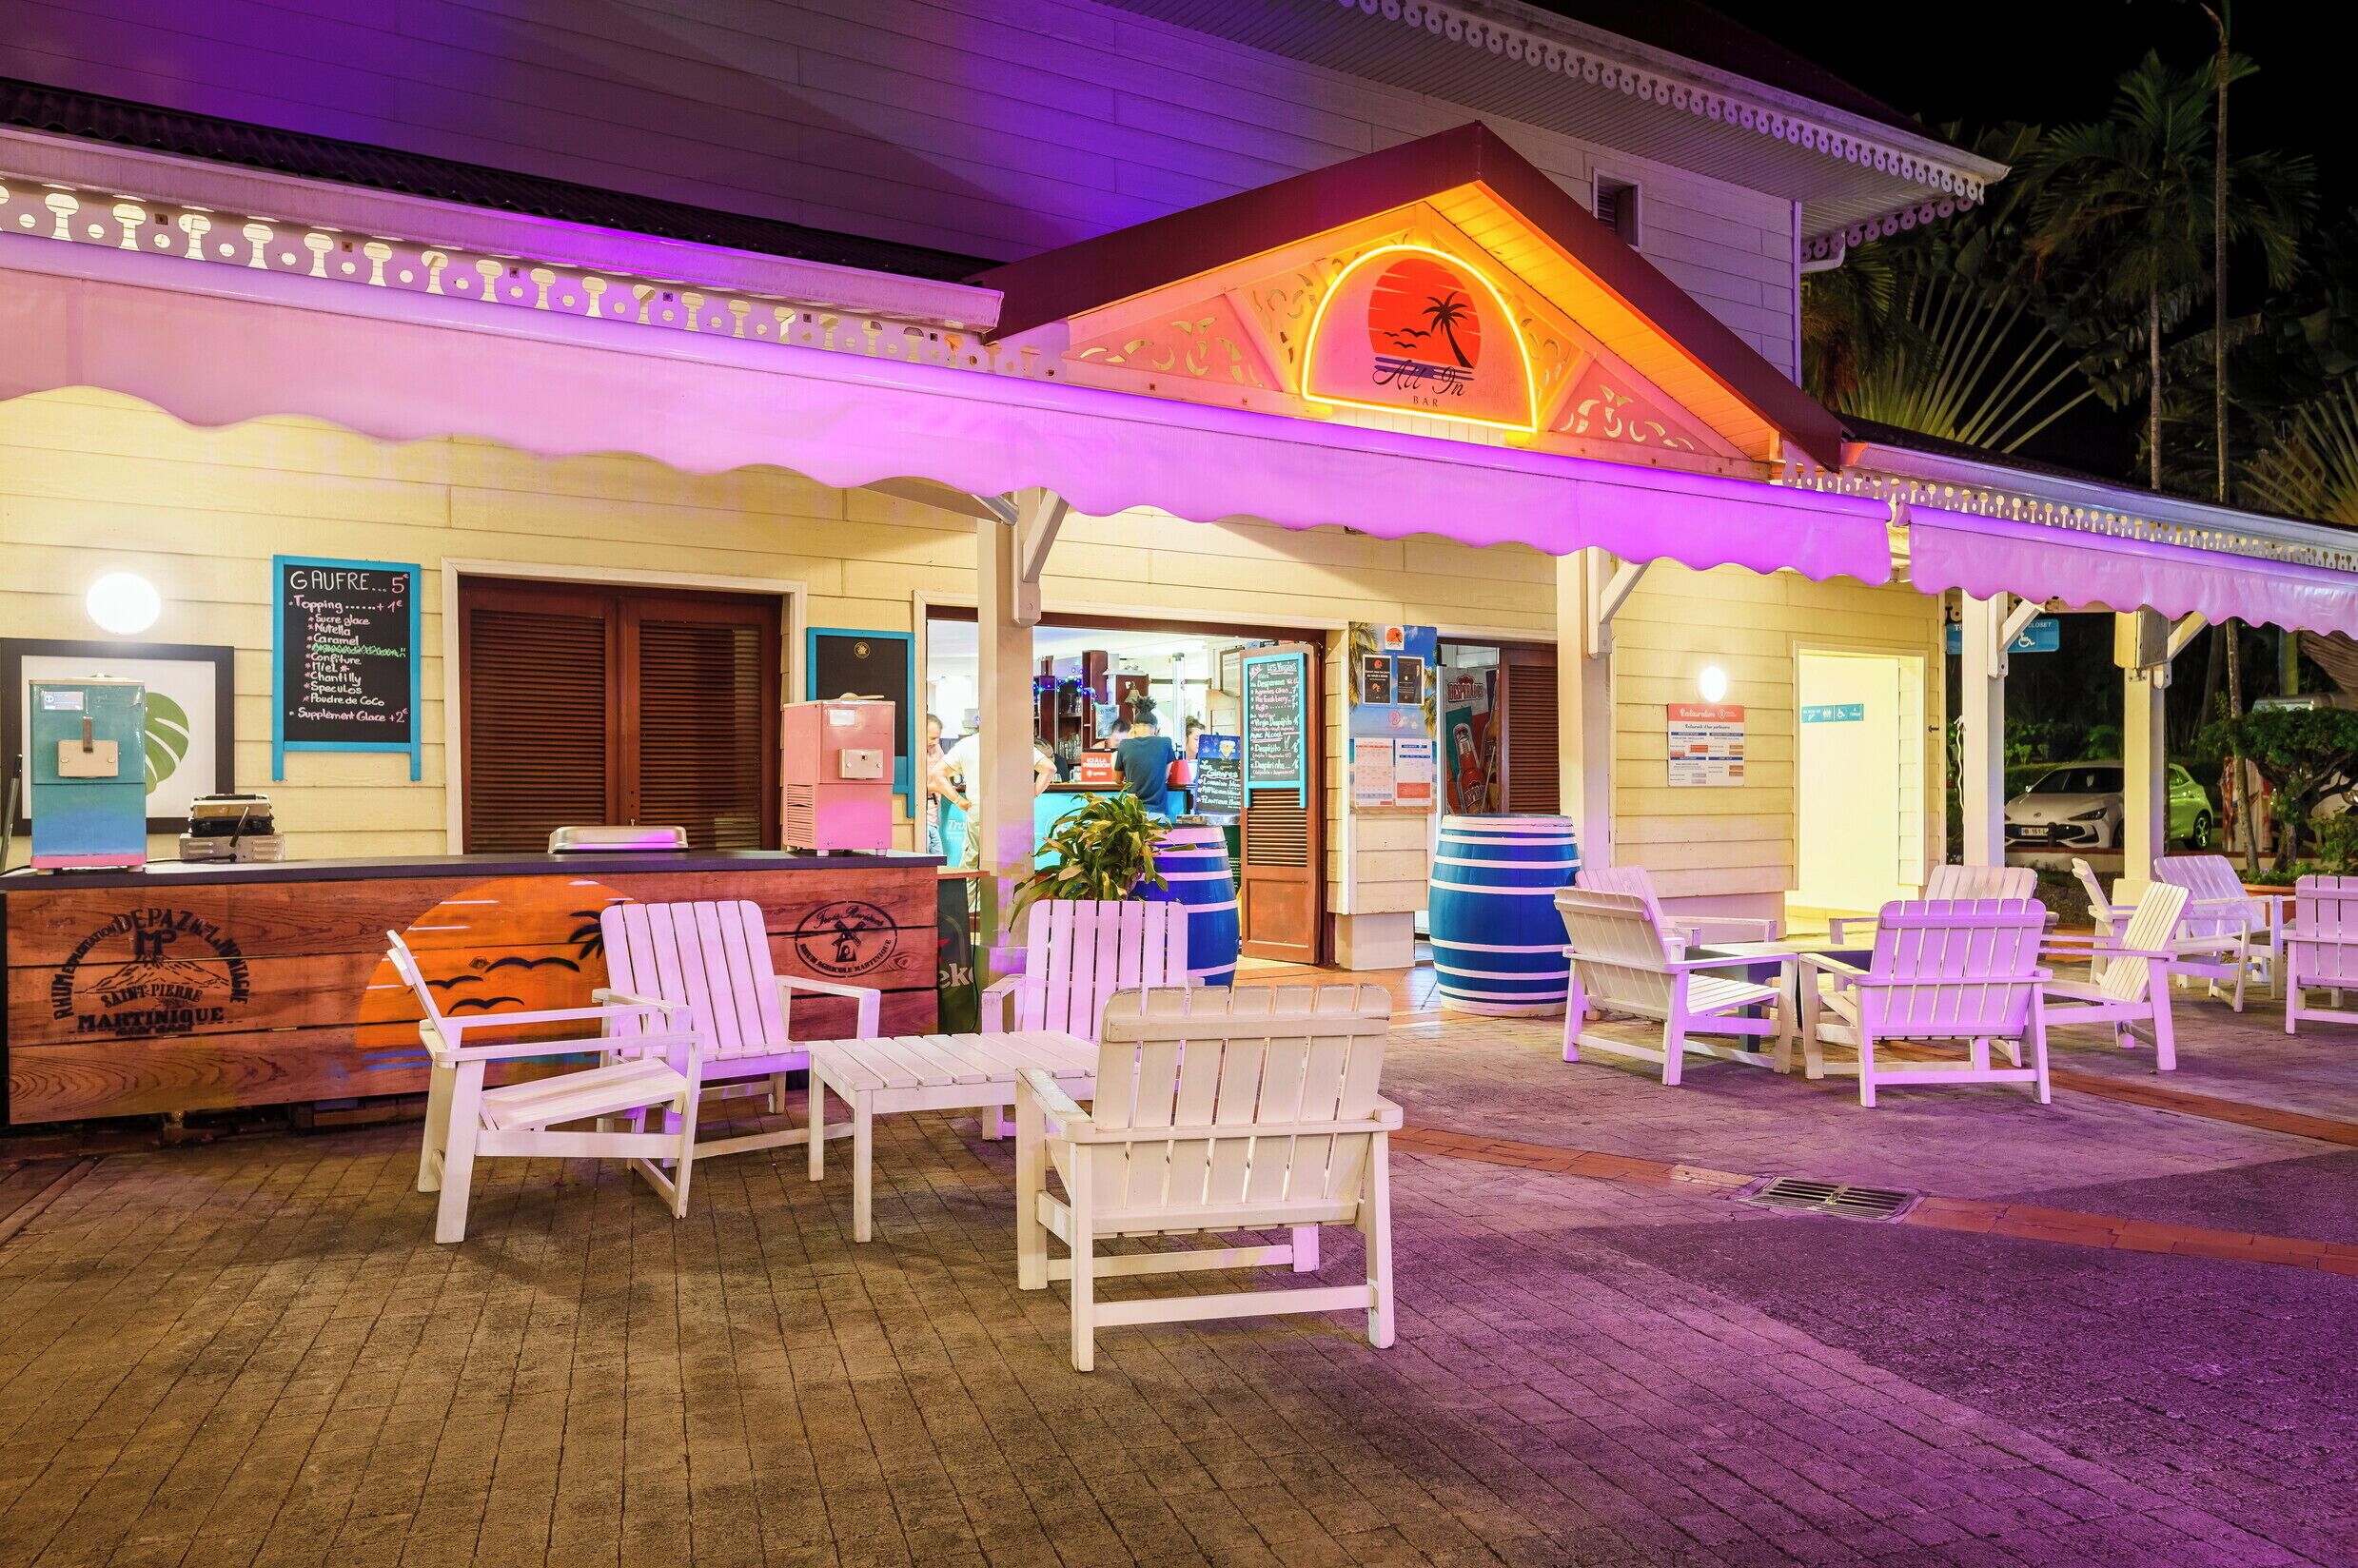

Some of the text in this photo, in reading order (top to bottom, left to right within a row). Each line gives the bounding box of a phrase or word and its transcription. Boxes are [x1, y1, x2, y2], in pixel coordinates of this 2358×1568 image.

[1373, 360, 1465, 396] All In
[1413, 395, 1438, 407] BAR
[315, 614, 370, 626] Sucre glace
[314, 623, 351, 636] Nutella
[313, 634, 359, 646] Caramel
[310, 653, 362, 665] Confiture
[310, 672, 362, 687] Chantilly
[310, 693, 344, 704] Poudre
[345, 694, 358, 705] de
[356, 710, 385, 722] Glace
[113, 908, 193, 934] DEPAZ
[854, 939, 892, 972] MARTINIQUE
[51, 973, 75, 1020] RHUM
[77, 1007, 225, 1031] MARTINIQUE
